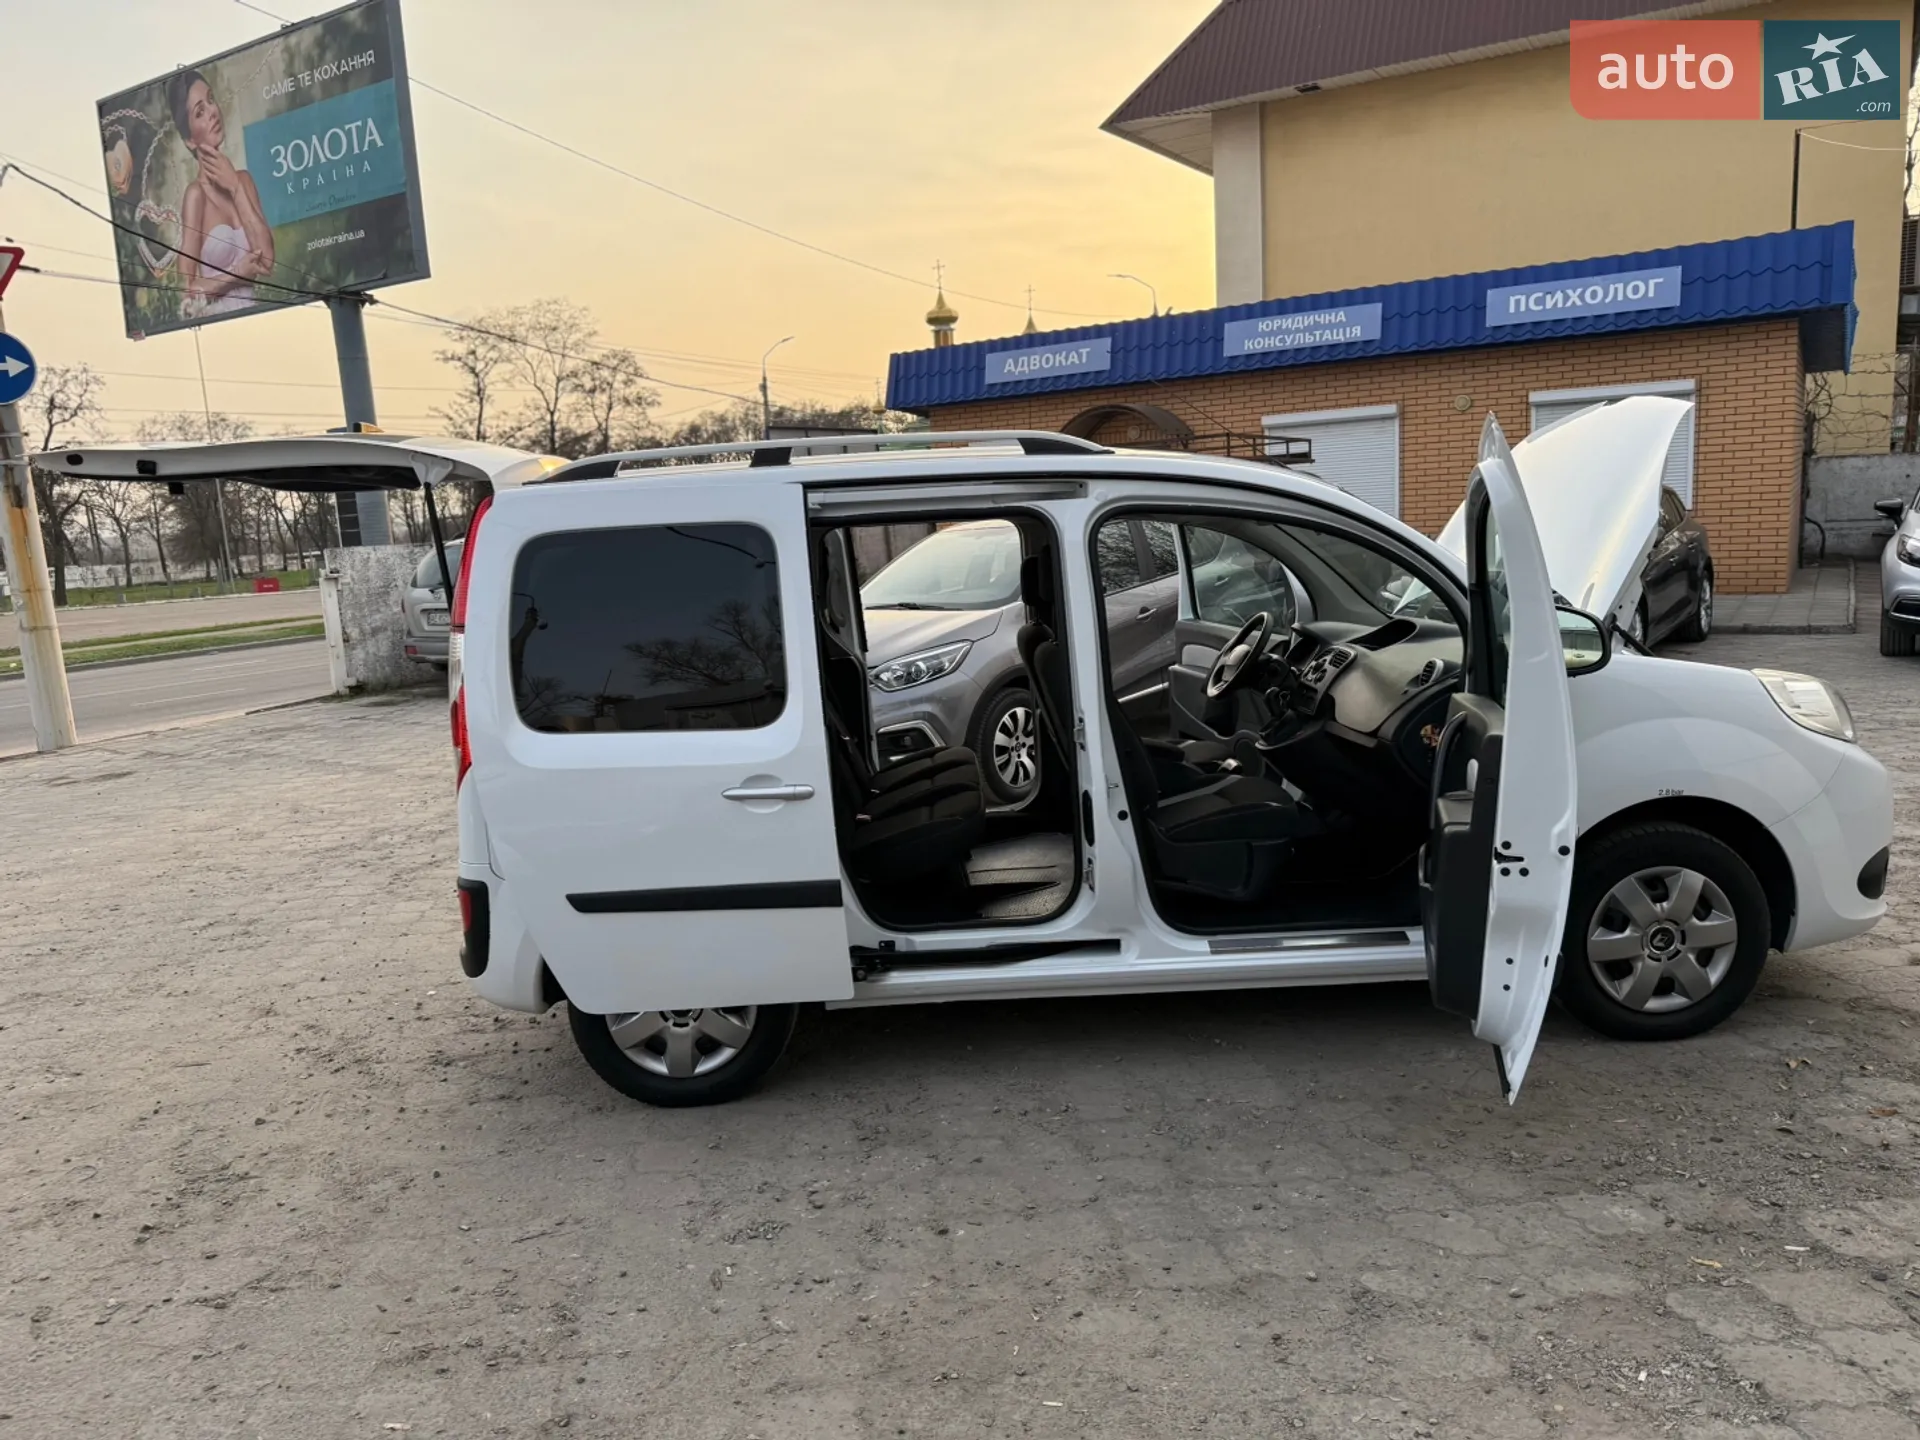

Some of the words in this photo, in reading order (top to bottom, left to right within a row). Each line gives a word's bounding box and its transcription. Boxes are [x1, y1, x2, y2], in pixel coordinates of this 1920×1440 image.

[262, 77, 296, 100] САМЕ
[297, 70, 312, 88] ТЕ
[313, 49, 376, 83] КОХАННЯ
[270, 117, 384, 177] ЗОЛОТА
[307, 229, 366, 251] zolotakraina.ua
[1508, 277, 1664, 314] ПСИХОЛОГ
[1257, 310, 1347, 333] ЮРИДИЧНА
[1244, 325, 1362, 351] КОНСУЛЬТАЦІЯ
[1003, 347, 1091, 376] АДВОКАТ
